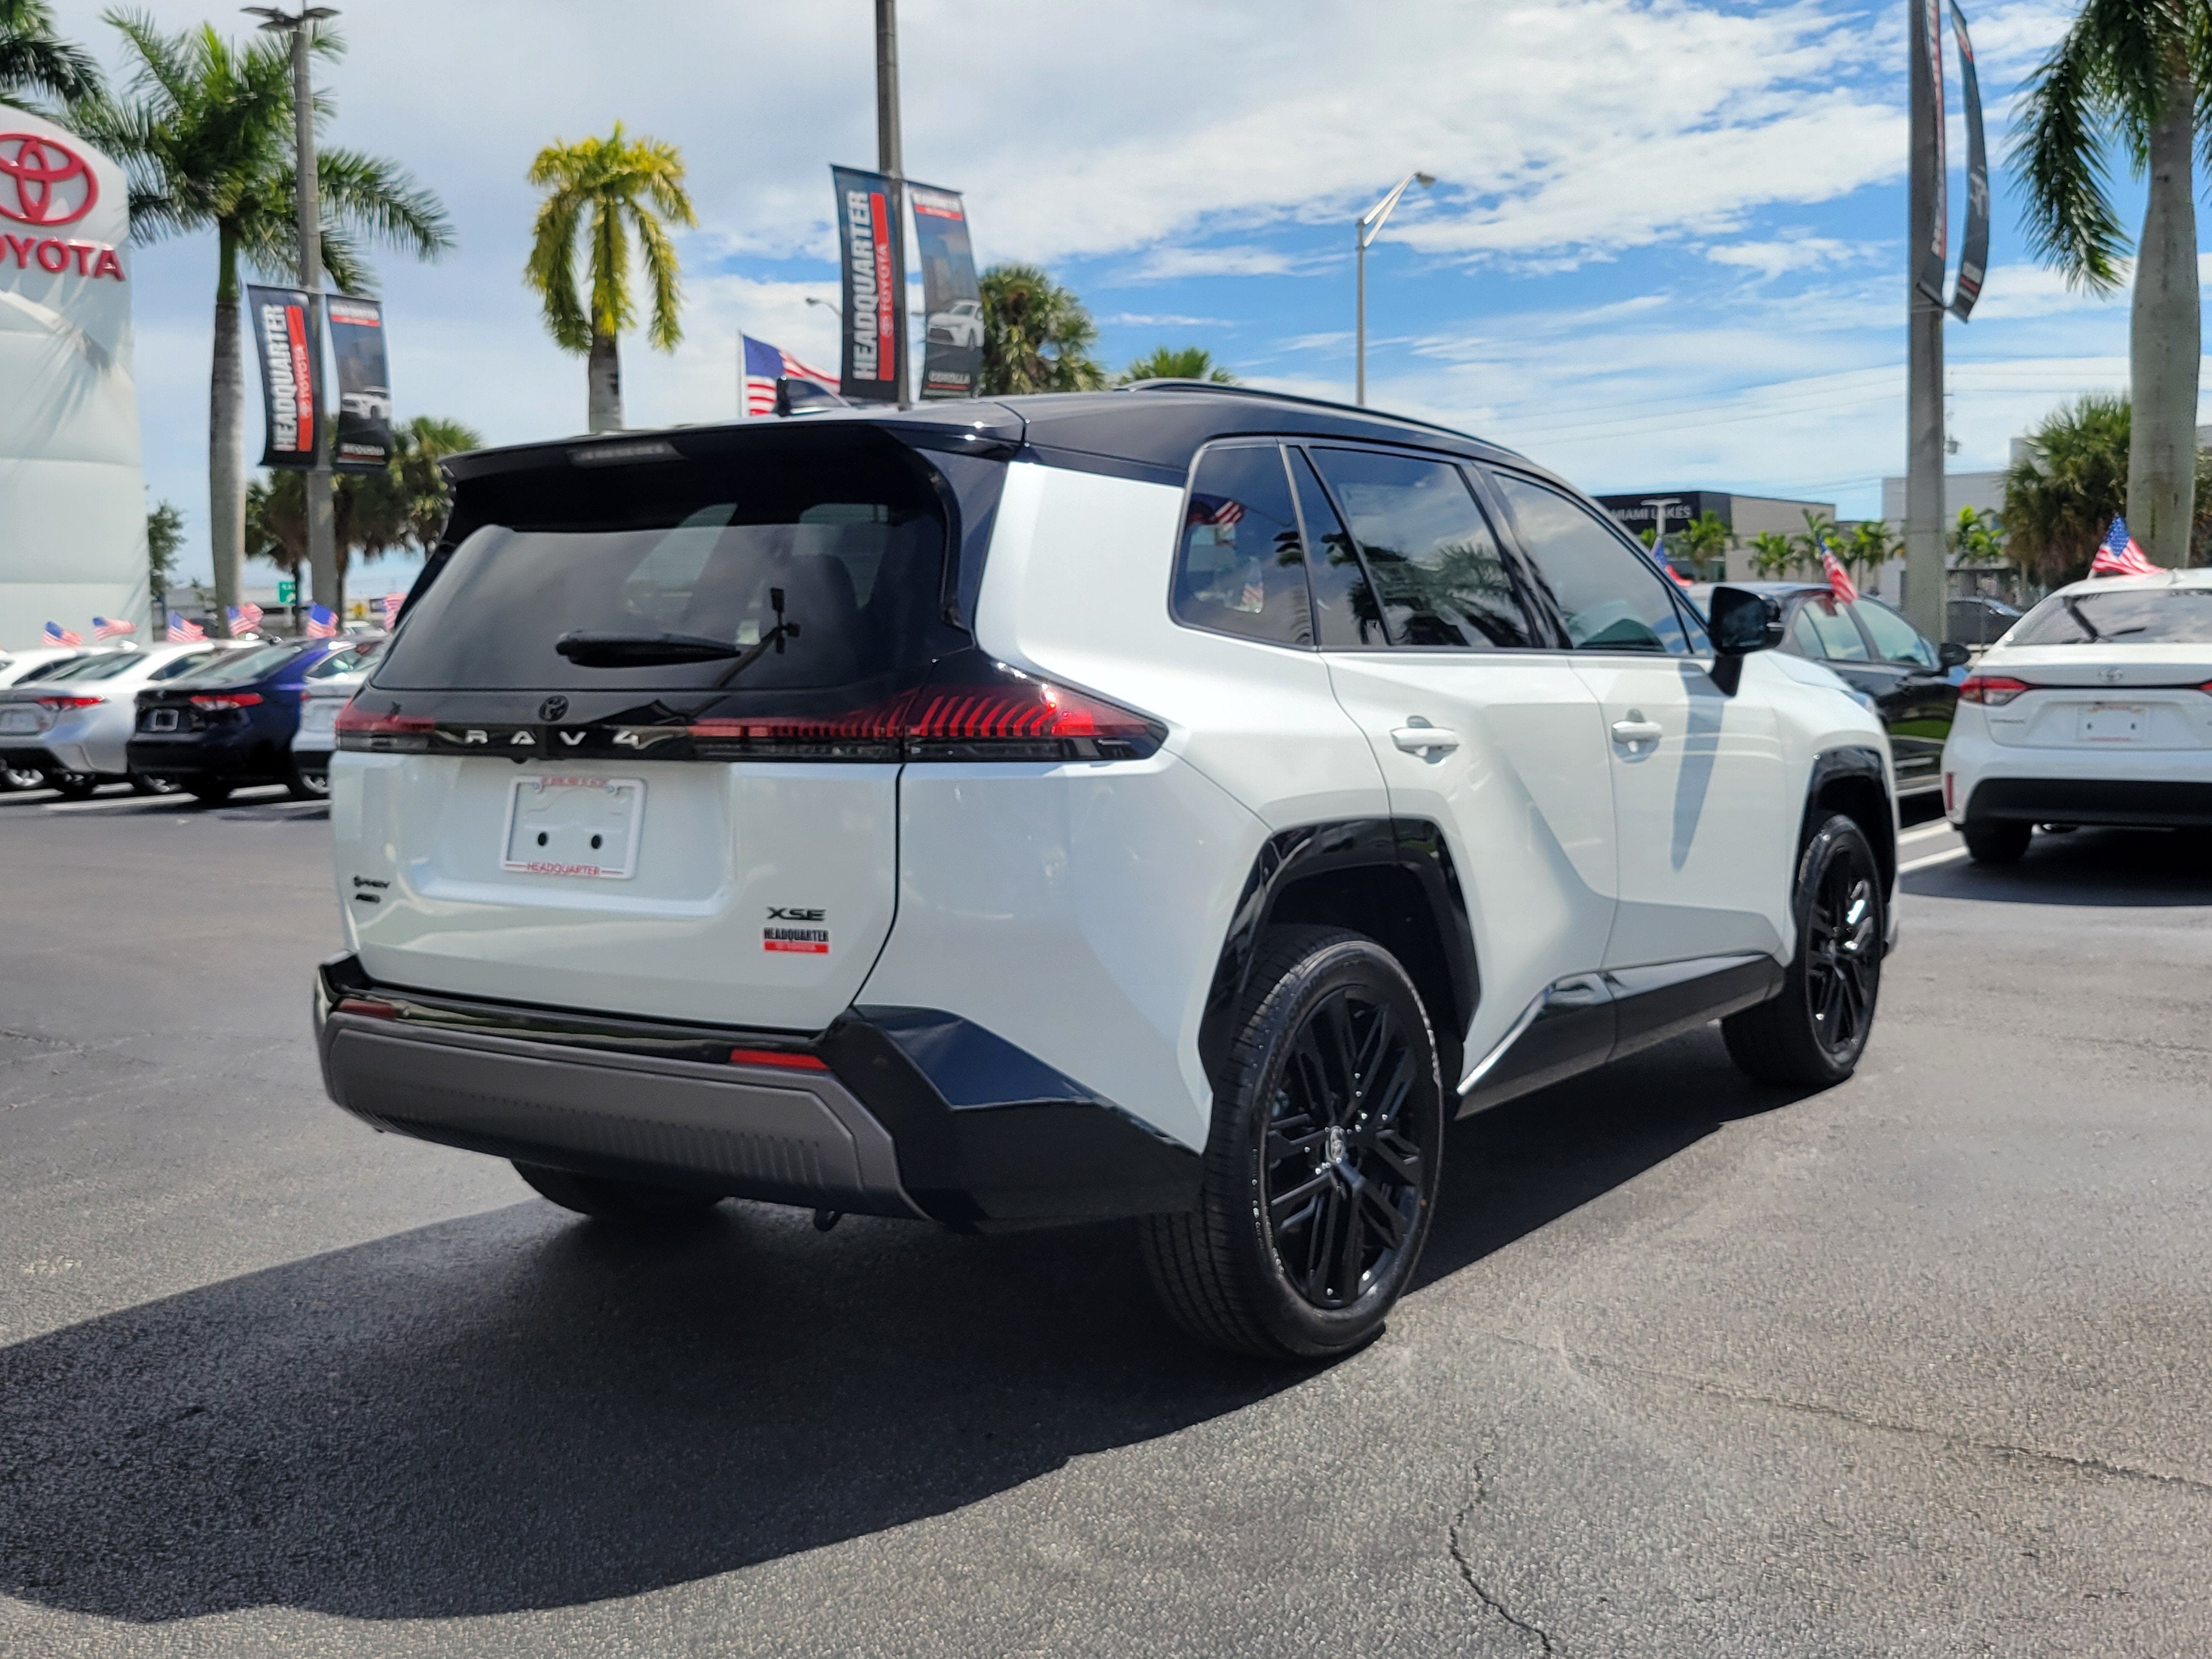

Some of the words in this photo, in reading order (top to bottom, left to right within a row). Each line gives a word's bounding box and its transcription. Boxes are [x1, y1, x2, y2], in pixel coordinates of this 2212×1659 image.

[0, 233, 126, 282] YOTA
[847, 190, 879, 380] HEADQUARTER
[877, 244, 893, 311] TOYOTA
[262, 303, 297, 451] HEADQUARTER
[1651, 505, 1692, 520] LKES
[464, 729, 639, 748] RAV4
[527, 862, 600, 876] HEADQUARTER
[768, 906, 826, 921] XSE
[764, 927, 828, 943] HEADQUARTER
